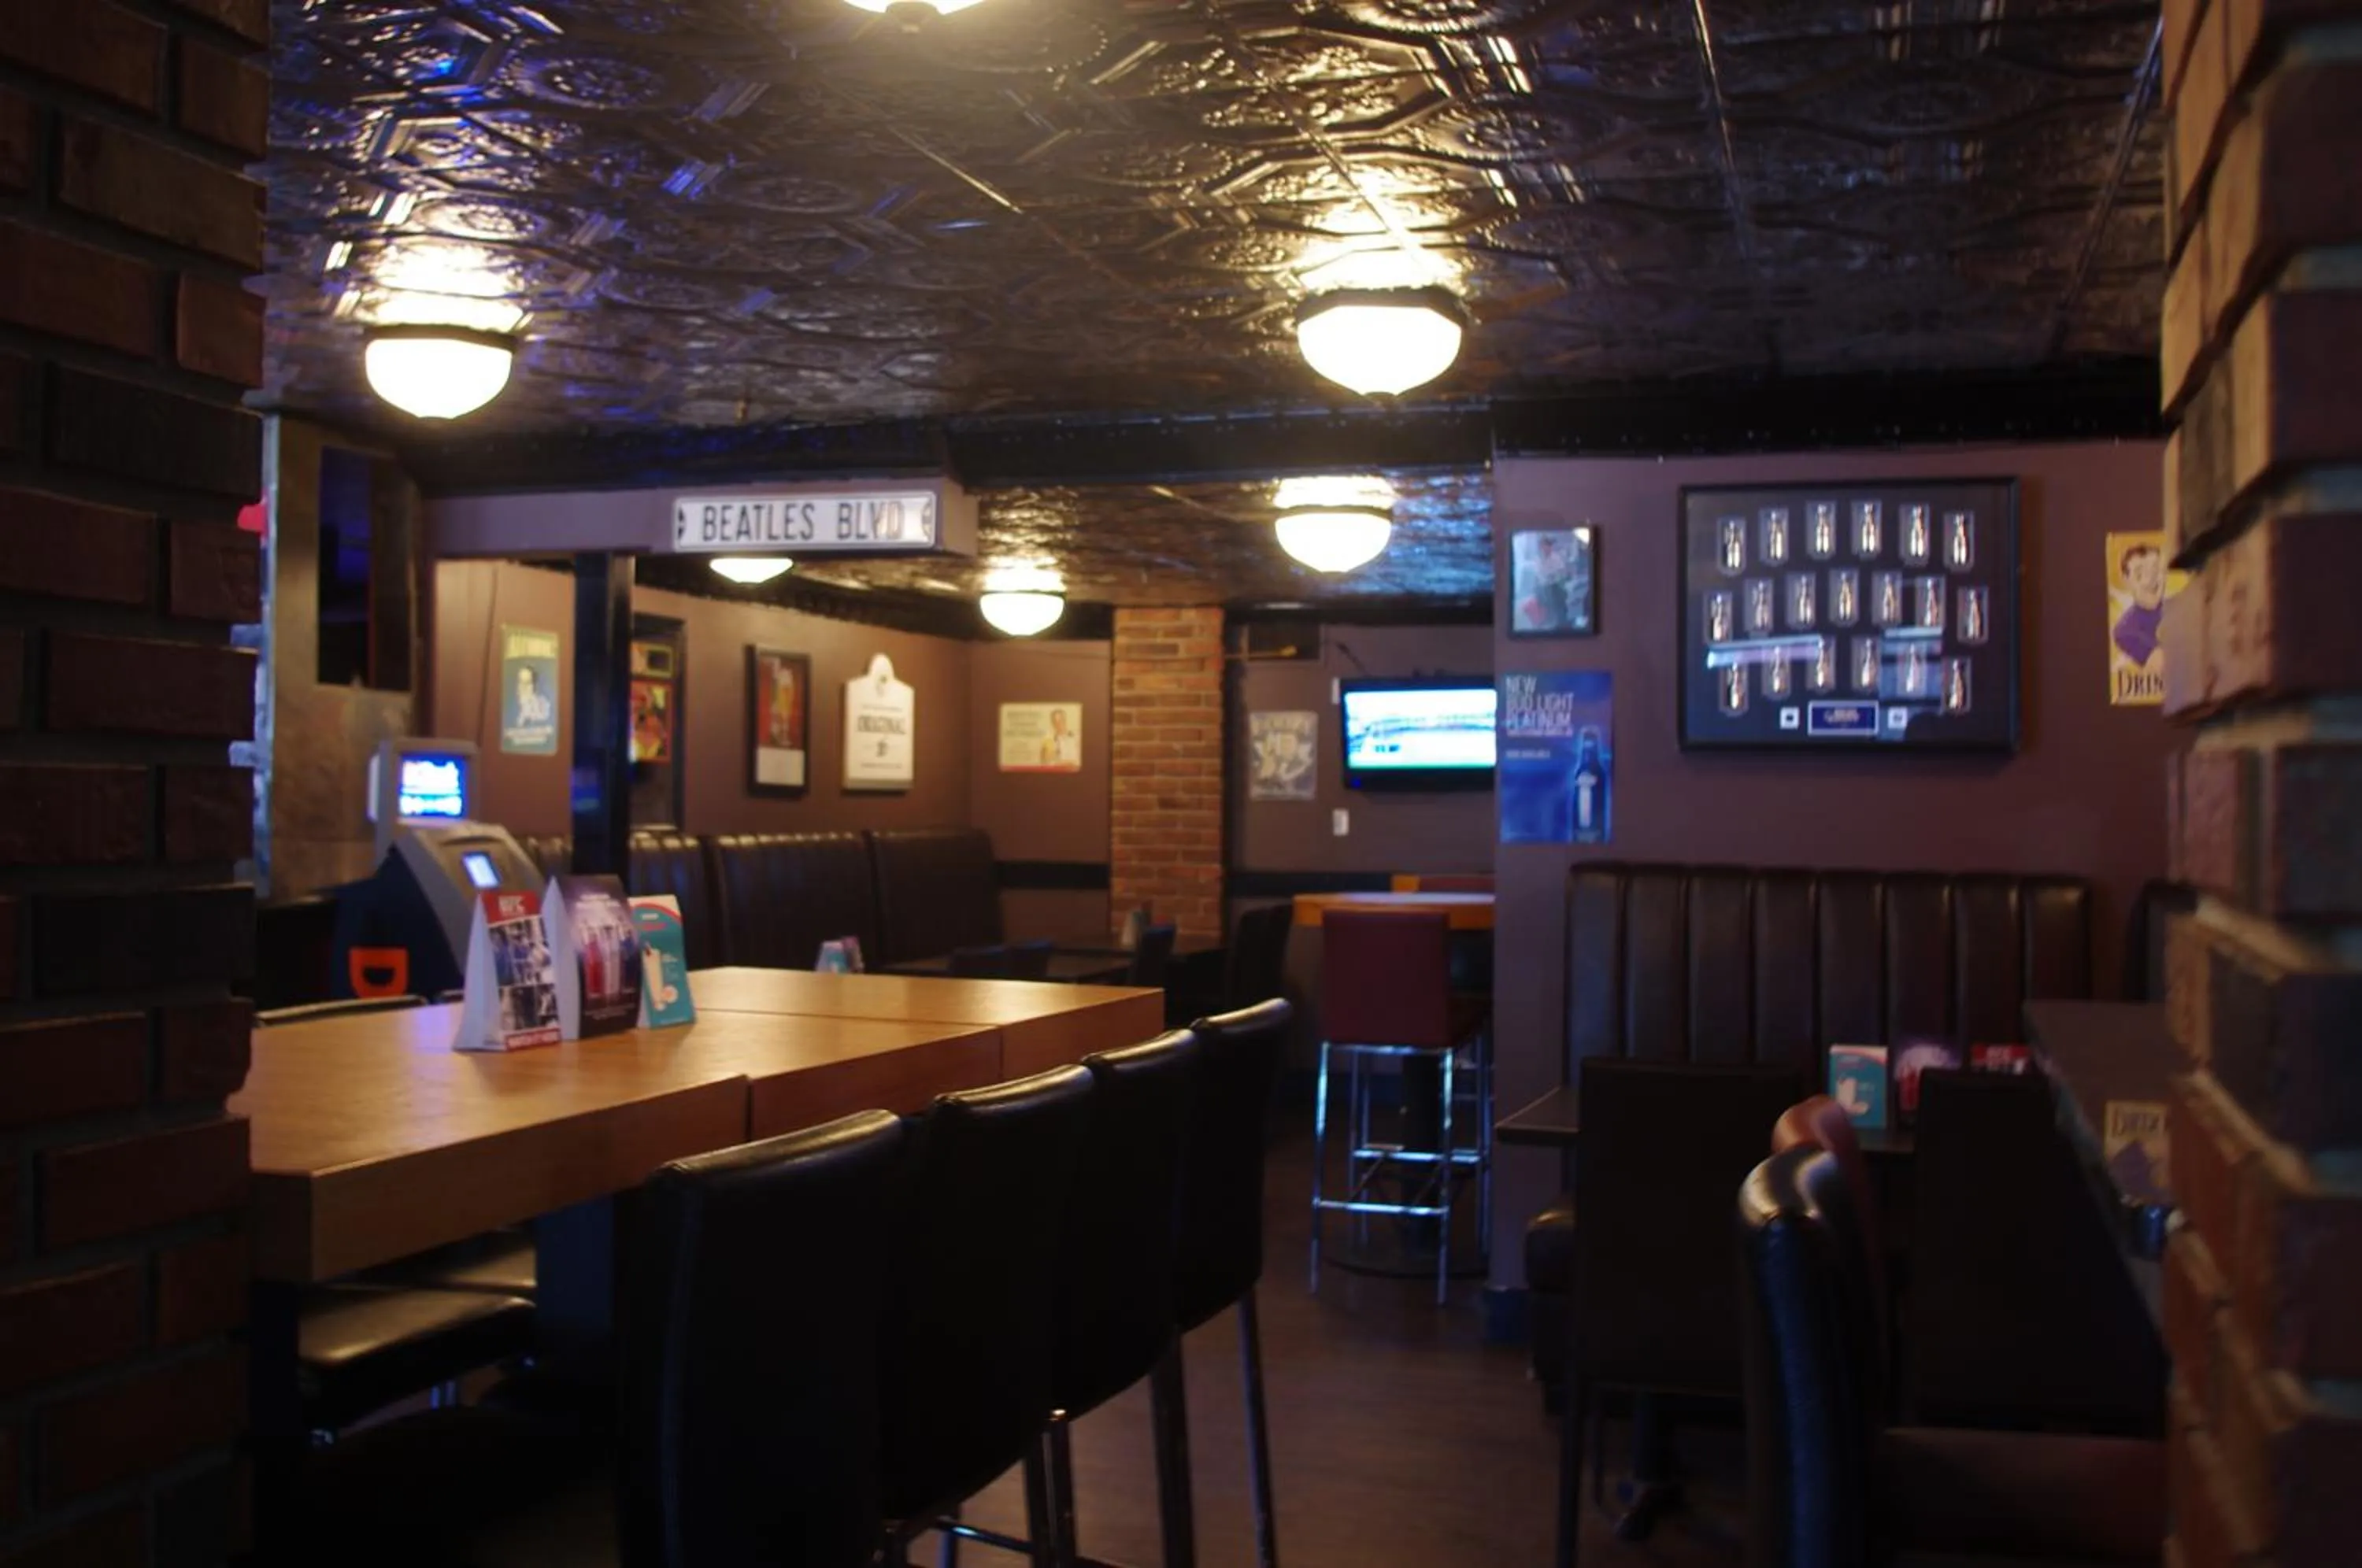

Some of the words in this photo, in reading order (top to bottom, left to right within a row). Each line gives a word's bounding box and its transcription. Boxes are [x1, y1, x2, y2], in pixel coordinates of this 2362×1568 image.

[702, 502, 815, 542] BEATLES
[836, 501, 905, 541] BLVD
[1505, 675, 1537, 693] NEW
